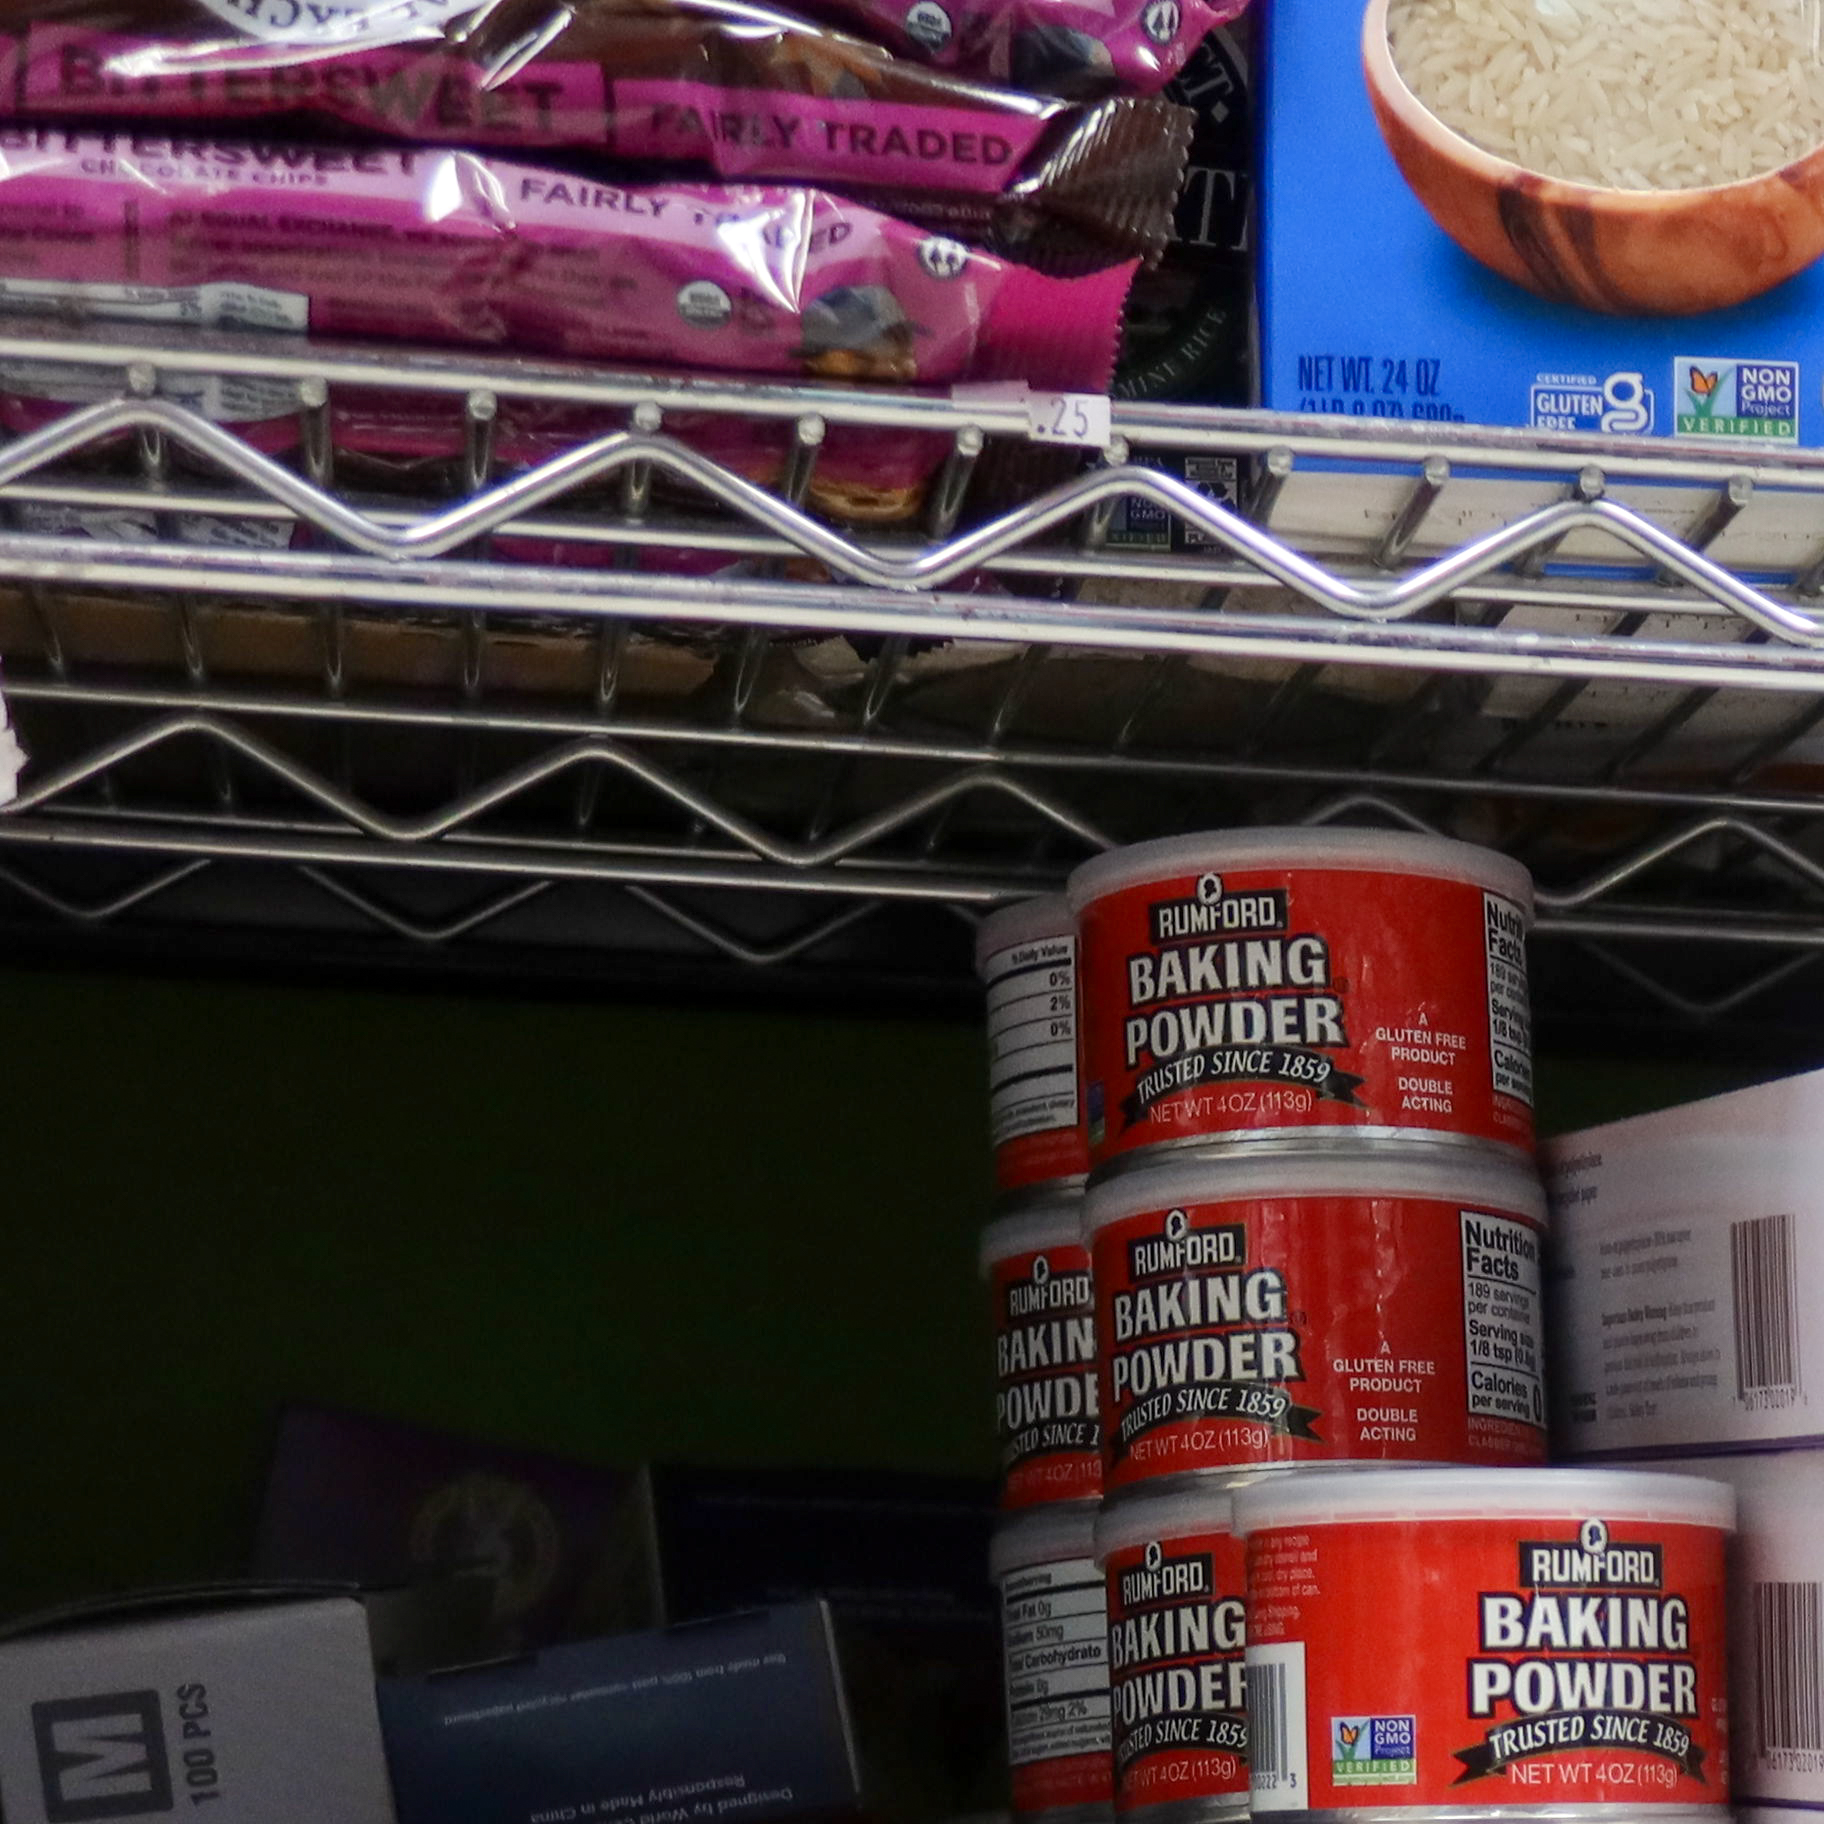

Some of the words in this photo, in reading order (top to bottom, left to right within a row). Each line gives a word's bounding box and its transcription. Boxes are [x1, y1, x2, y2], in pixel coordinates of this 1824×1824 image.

[818, 118, 1014, 169] TRADED
[1299, 354, 1333, 392] NET
[1382, 359, 1407, 395] 24
[1416, 360, 1441, 396] OZ
[1741, 385, 1792, 402] GMO
[1743, 368, 1791, 386] NON
[1684, 417, 1791, 435] VERIFIED
[1131, 939, 1329, 1003] BAKING
[1126, 998, 1345, 1067] POWDER
[1137, 1056, 1206, 1104] TRUSTED
[1211, 1051, 1271, 1078] SINCE
[1280, 1053, 1332, 1083] 1859
[1483, 1596, 1688, 1650] BAKING
[179, 1683, 211, 1740] PCS
[1471, 1663, 1697, 1716] POWDER
[183, 1747, 220, 1806] 100
